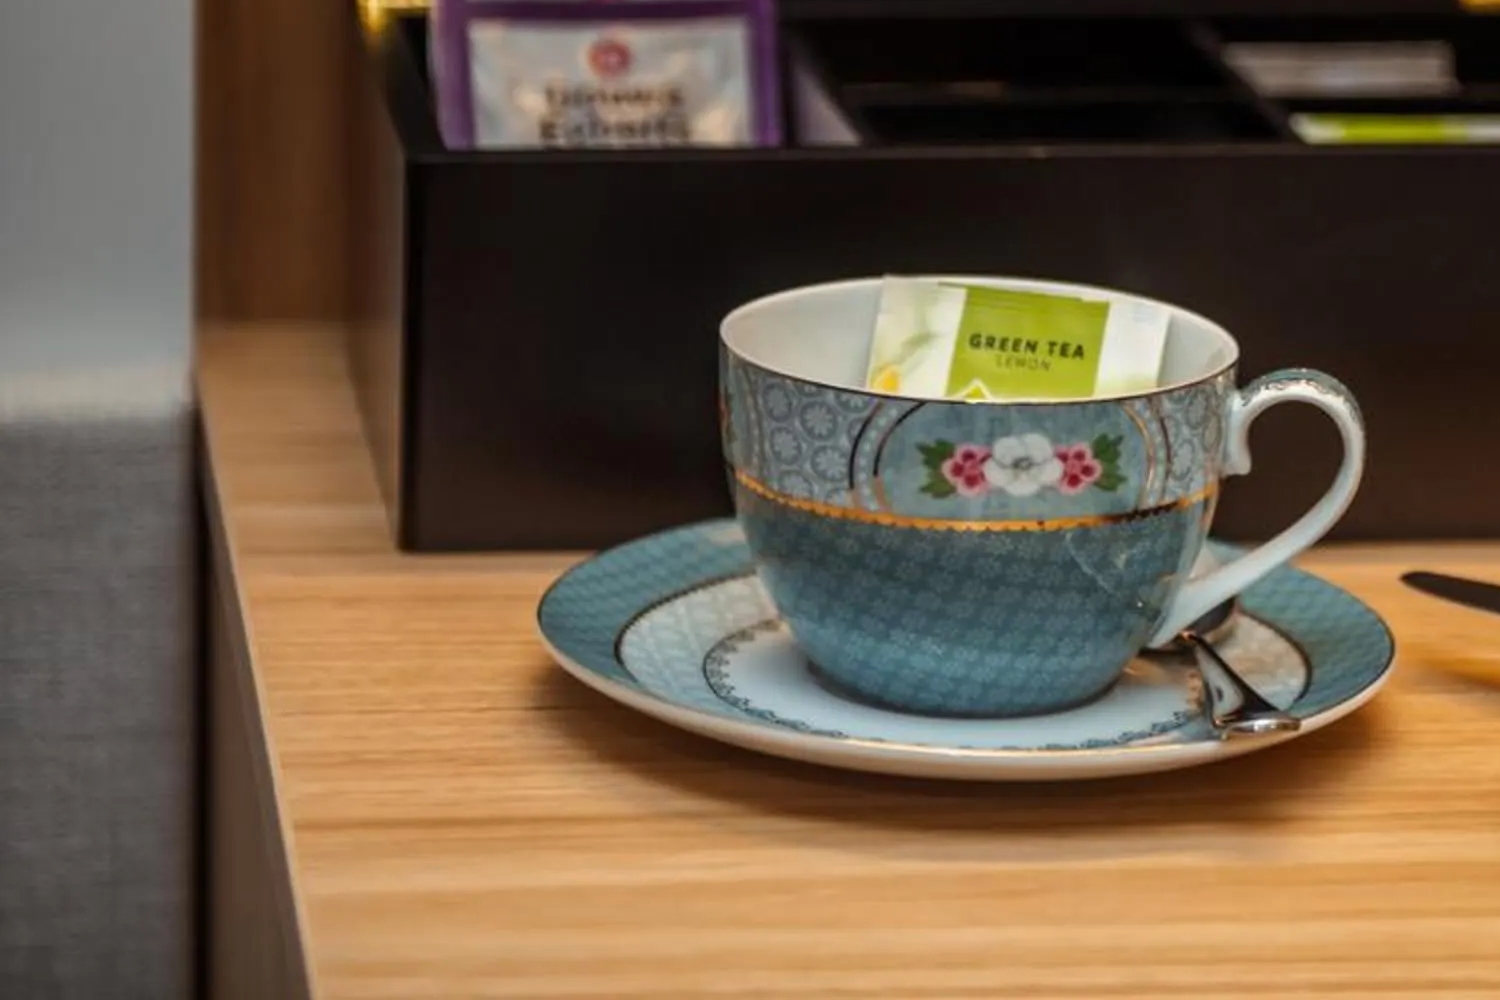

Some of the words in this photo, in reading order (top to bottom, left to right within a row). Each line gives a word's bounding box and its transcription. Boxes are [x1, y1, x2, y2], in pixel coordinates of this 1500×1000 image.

[968, 332, 1039, 356] GREEN
[1047, 340, 1085, 361] TEA
[994, 353, 1052, 373] LEMON
